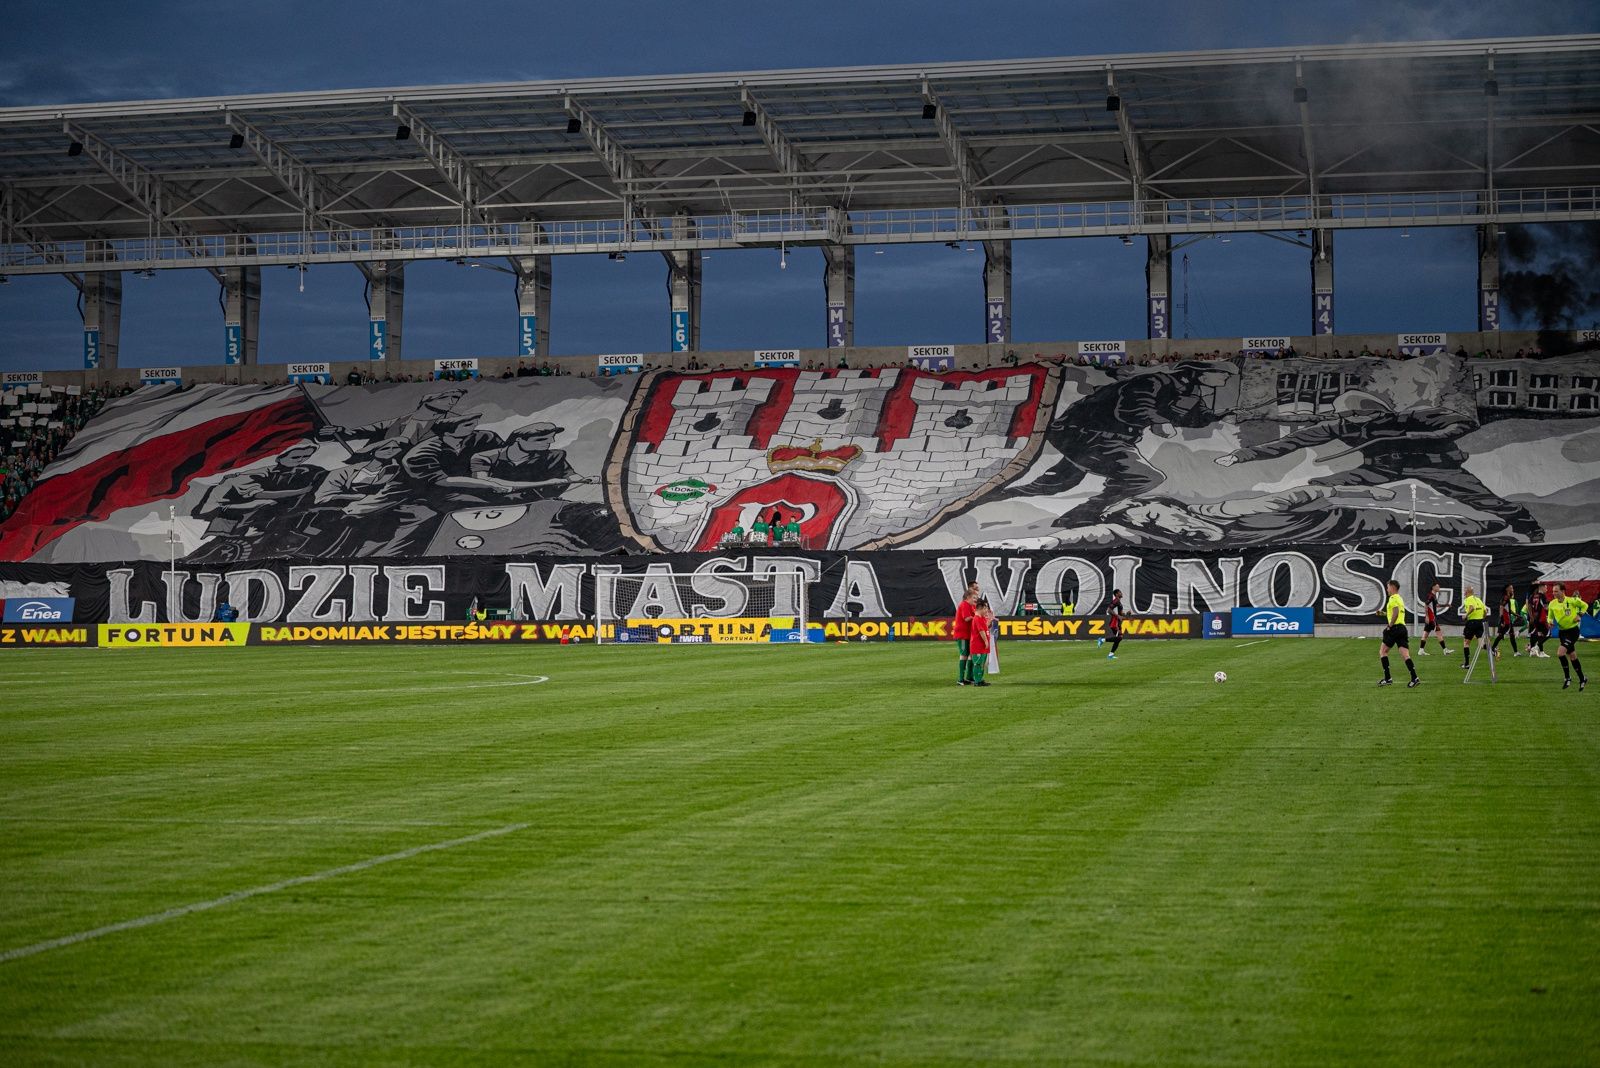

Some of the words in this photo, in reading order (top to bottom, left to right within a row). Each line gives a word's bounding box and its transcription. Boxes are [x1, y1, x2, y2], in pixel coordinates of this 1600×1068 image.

[1248, 339, 1285, 348] SEKTOR
[1403, 335, 1441, 344] SEKTOR
[913, 347, 949, 356] SEKTOR
[1083, 343, 1120, 352] SEKTOR
[603, 355, 638, 364] SEKTOR
[759, 352, 795, 360] SEKTOR
[292, 365, 325, 373] SEKTOR
[439, 360, 473, 369] SEKTOR
[7, 373, 38, 382] SEKTOR
[144, 369, 177, 378] SEKTOR
[106, 564, 446, 624] LUDZIE
[505, 555, 893, 621] MIASTA
[21, 608, 62, 620] Enea
[952, 616, 1082, 637] TEŚMY
[1088, 620, 1106, 635] Z
[1252, 618, 1300, 631] Enea
[1, 629, 17, 643] Z
[21, 628, 88, 643] WAMI
[107, 628, 235, 643] FORTUNA
[260, 625, 390, 641] RADOMIAK
[395, 621, 516, 641] JESTEŚMY
[520, 624, 538, 640] Z
[541, 623, 616, 640] WAMI
